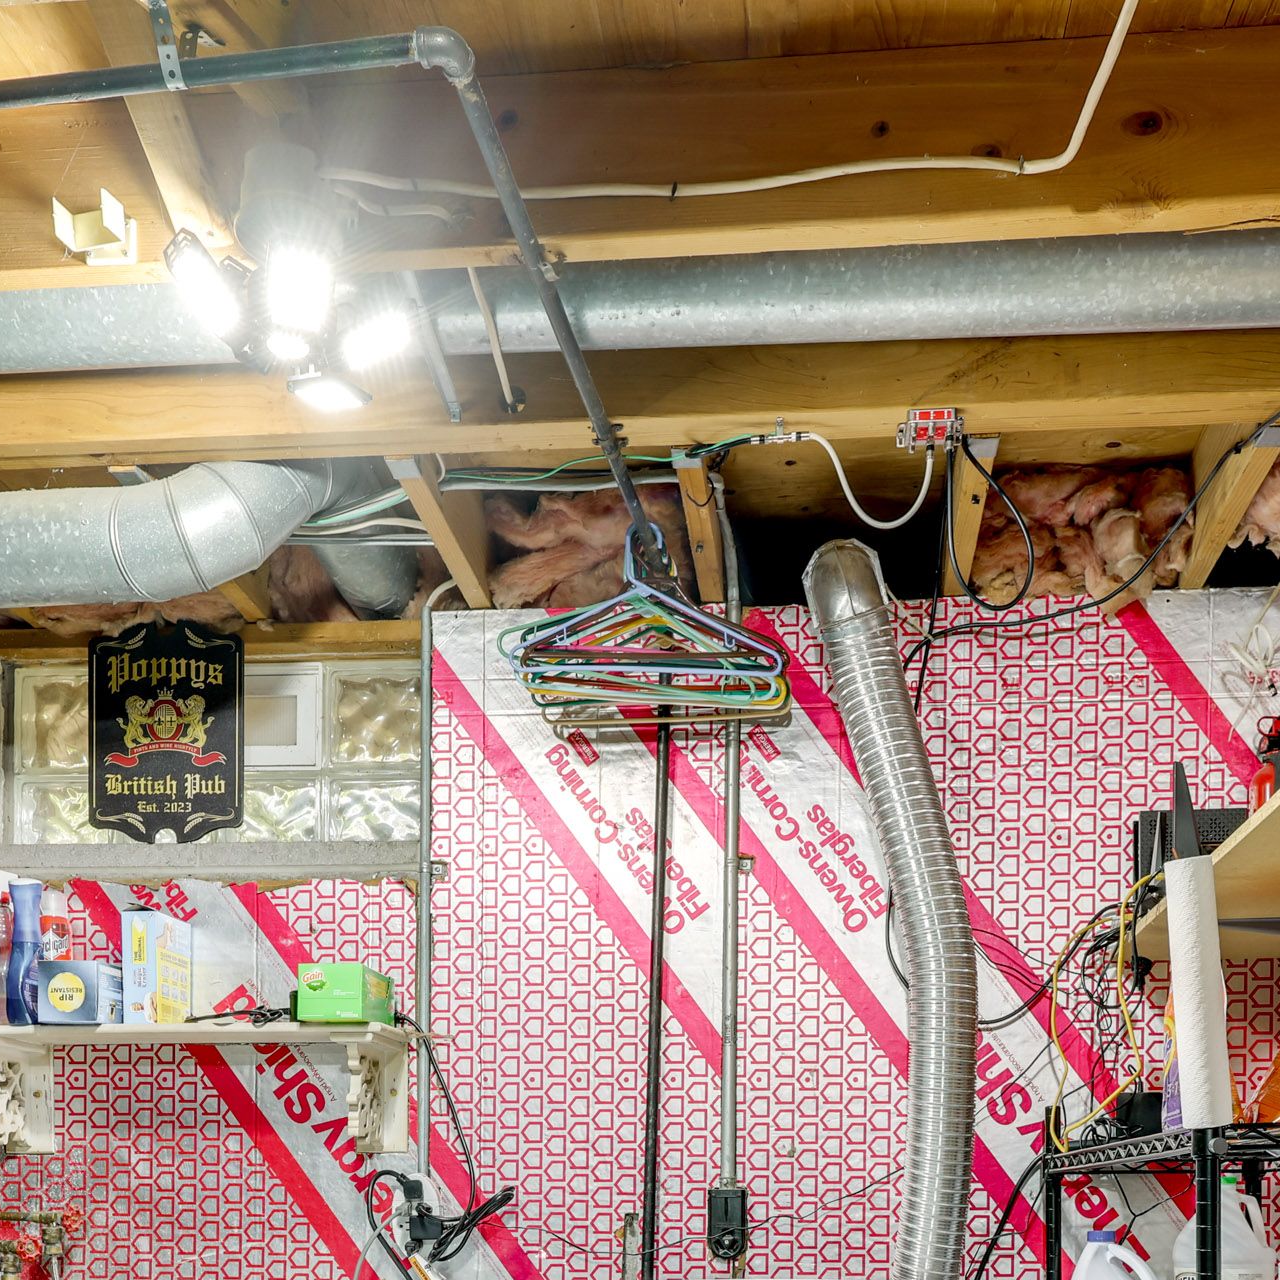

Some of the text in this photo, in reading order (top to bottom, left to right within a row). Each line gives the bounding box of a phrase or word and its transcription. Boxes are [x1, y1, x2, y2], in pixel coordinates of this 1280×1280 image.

[107, 652, 225, 694] Poppys
[104, 772, 226, 800] British Pub
[137, 800, 192, 813] Est. 2023
[799, 797, 898, 921] Fiberglas
[302, 971, 323, 983] Gain
[50, 986, 83, 994] RESISTANT
[58, 993, 74, 1001] RIP
[316, 1079, 334, 1098] rigid
[1012, 1111, 1151, 1278] Enery
